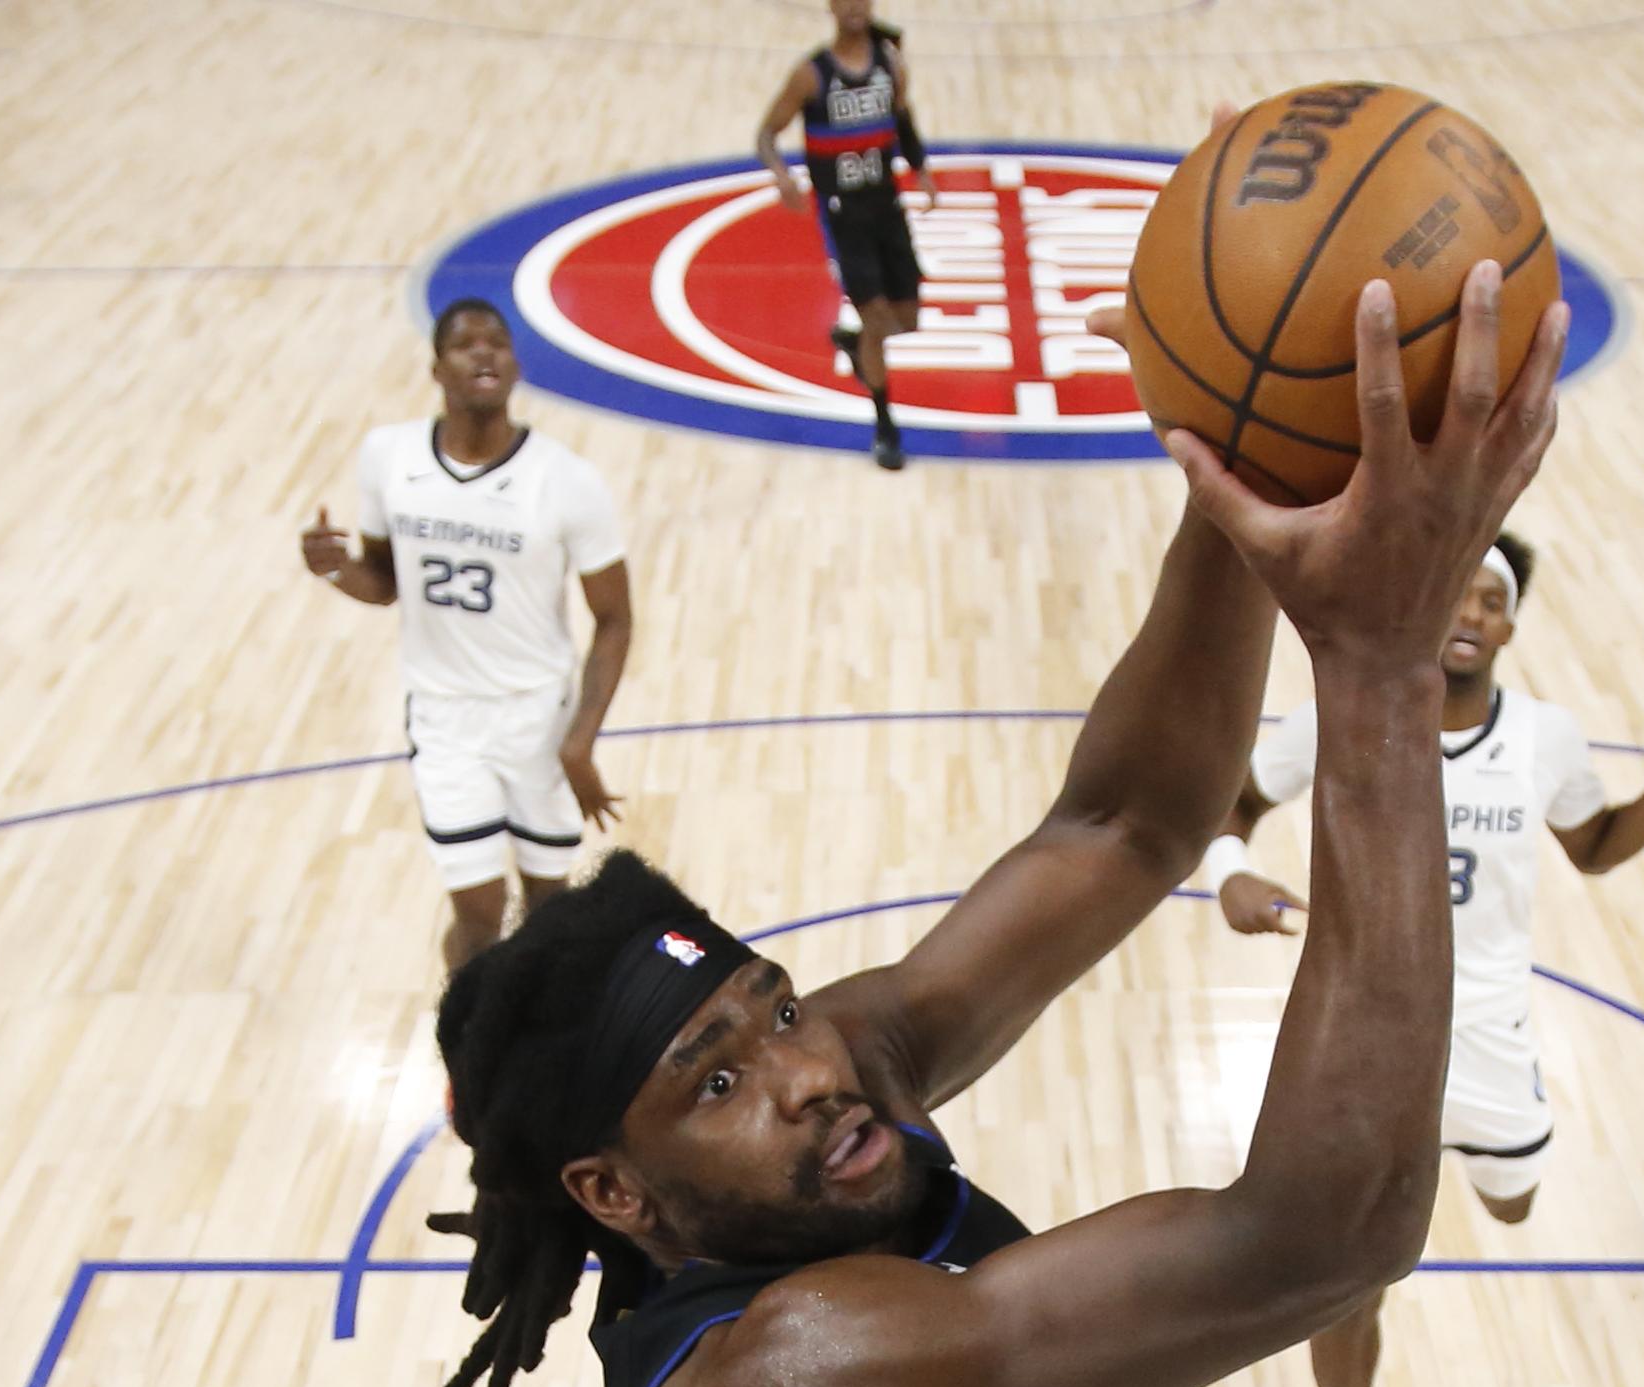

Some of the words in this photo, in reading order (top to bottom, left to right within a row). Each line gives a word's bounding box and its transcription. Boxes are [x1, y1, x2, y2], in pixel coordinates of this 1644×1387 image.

[393, 513, 524, 553] MEMPHIS
[420, 553, 495, 613] 23
[1447, 804, 1526, 833] PHIS
